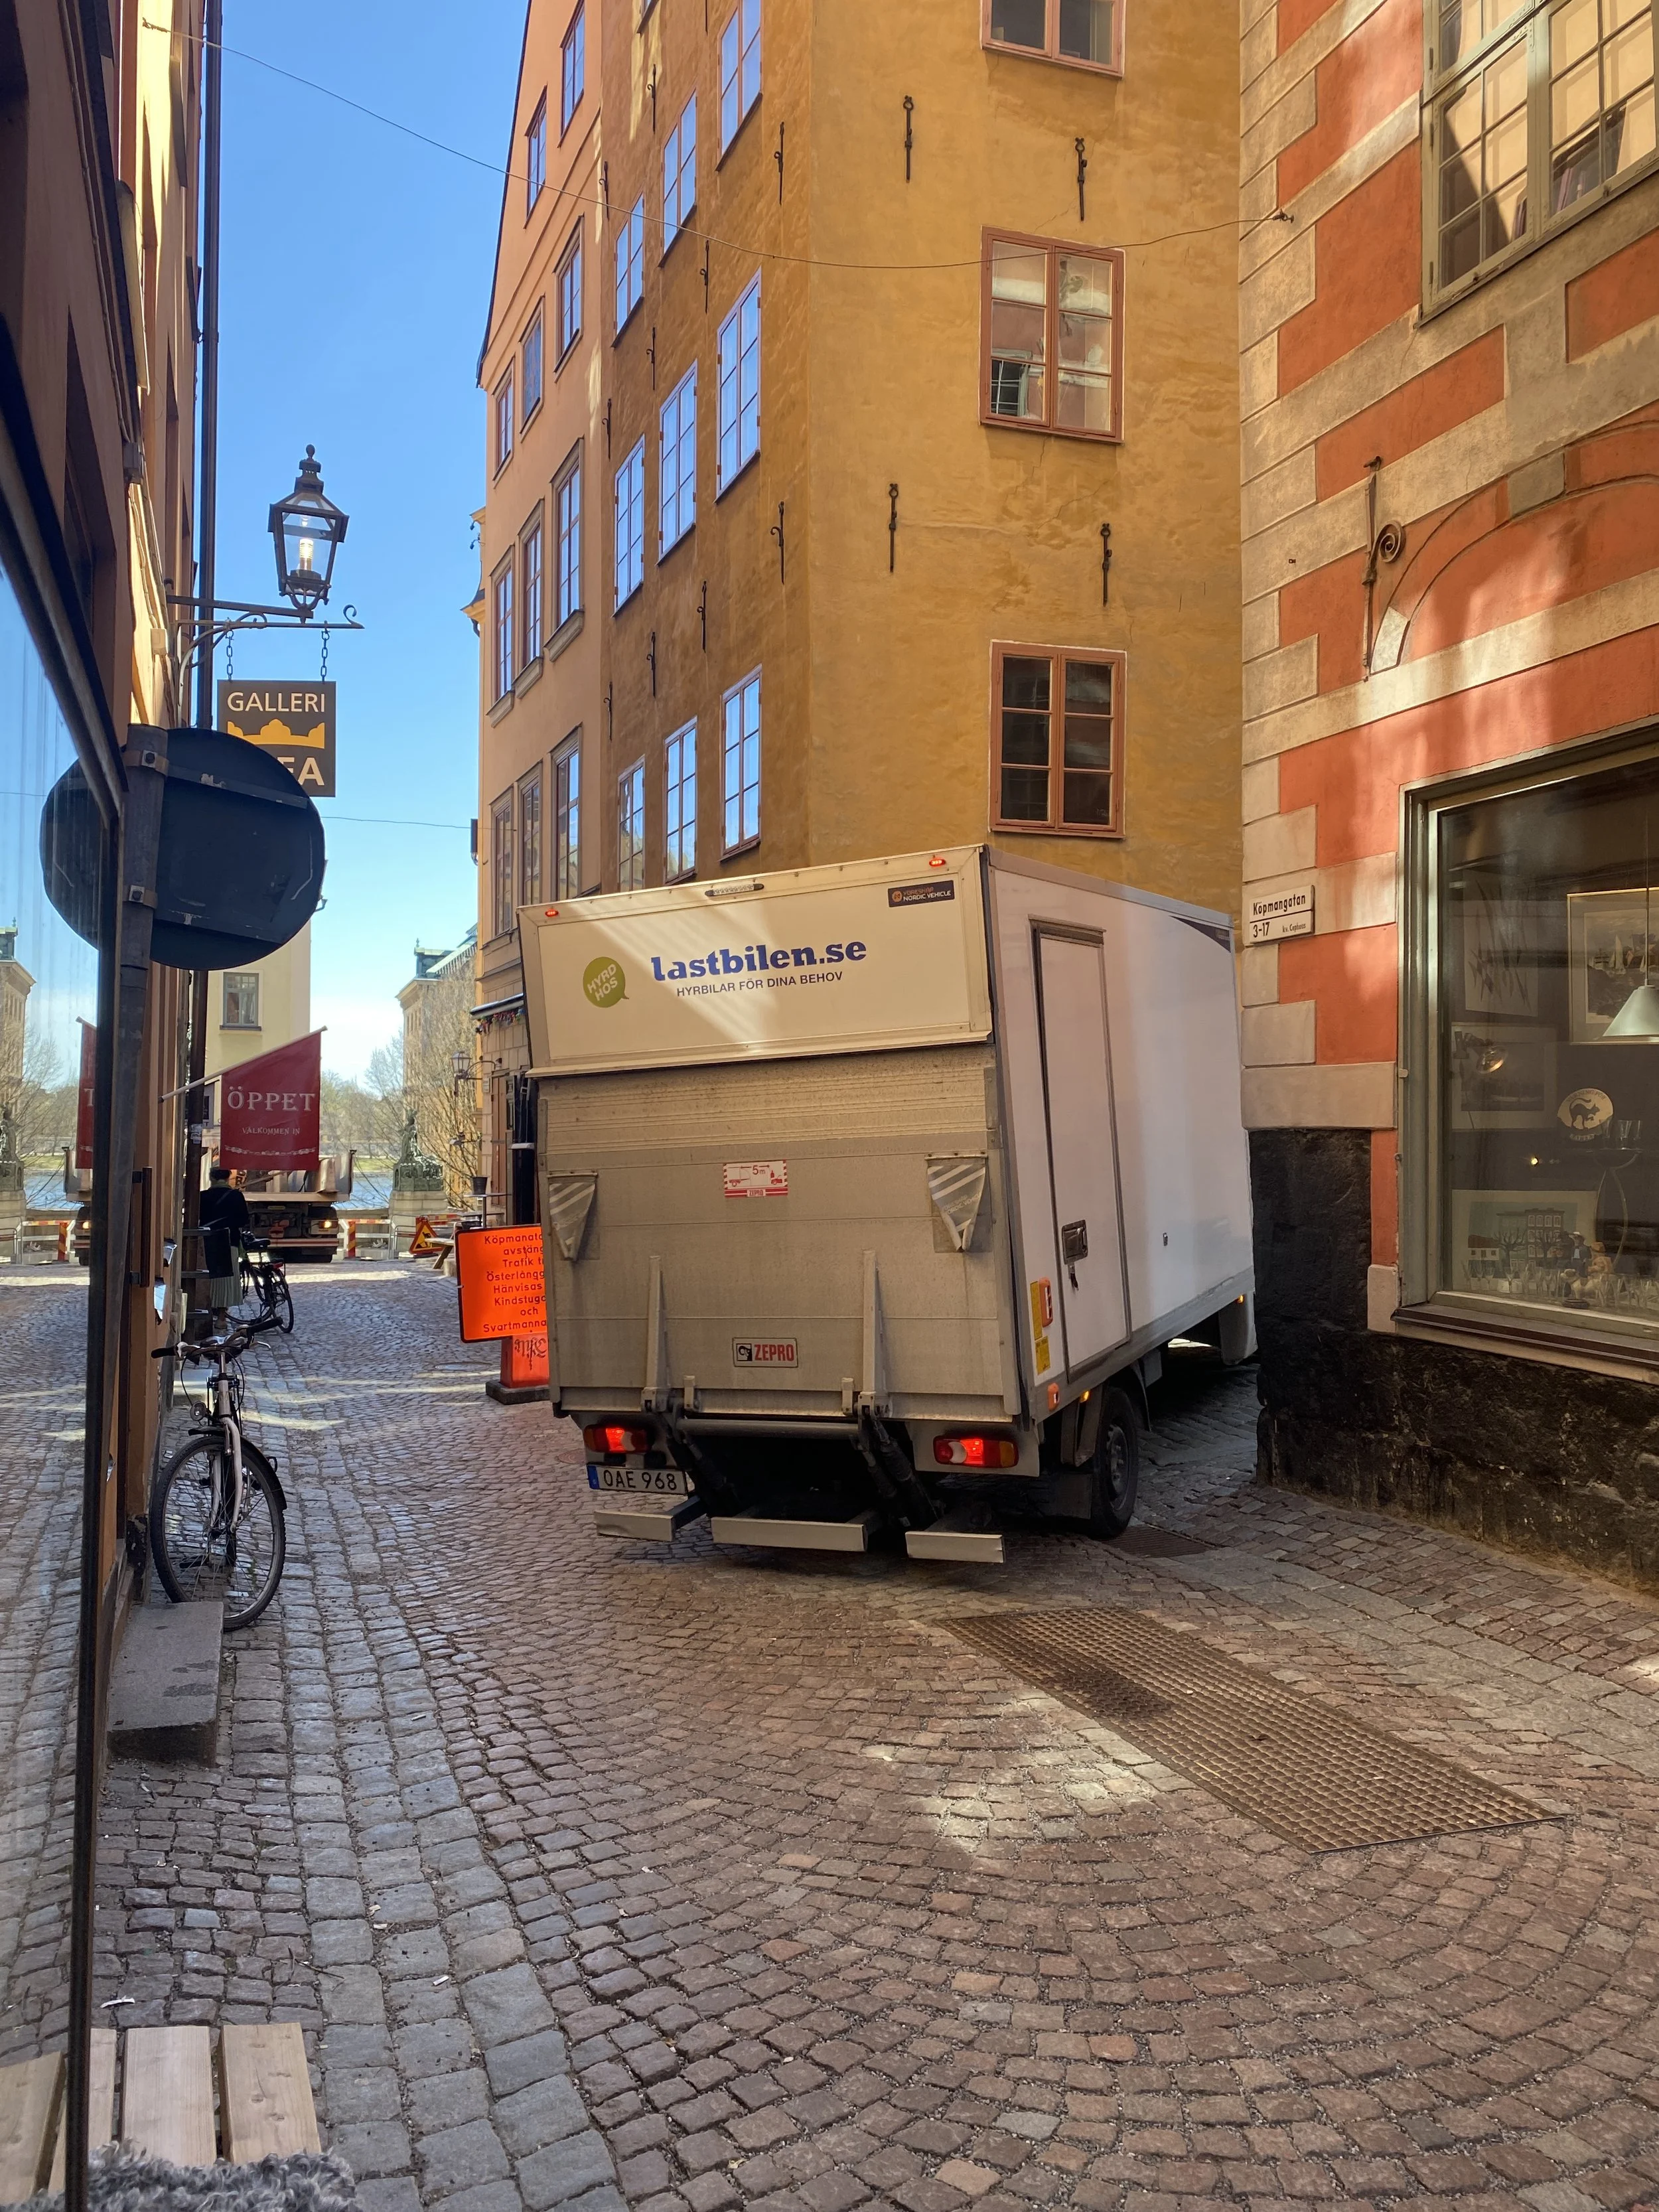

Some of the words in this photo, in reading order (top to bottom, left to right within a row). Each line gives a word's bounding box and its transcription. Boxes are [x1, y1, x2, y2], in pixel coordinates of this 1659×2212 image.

[227, 692, 325, 712] GALLERI
[926, 890, 951, 899] VEHICLE
[1253, 893, 1306, 917] Köpmangatan
[1253, 921, 1270, 938] 3-17
[650, 941, 867, 982] lastbilen.se
[587, 964, 617, 994] HYRD
[595, 976, 618, 1001] HOS
[676, 982, 735, 997] HYRBILAR
[739, 978, 764, 990] FÖR
[767, 976, 796, 988] DINA
[800, 971, 843, 985] BEHOV
[227, 1086, 315, 1112] ÖPPET
[293, 1127, 300, 1136] IN
[502, 1257, 534, 1268] Trafik
[494, 1283, 543, 1294] Hänvisas
[520, 1307, 538, 1316] och
[483, 1319, 546, 1333] Svartmanna
[754, 1343, 794, 1361] ZEPRO
[603, 1469, 636, 1489] OAE
[641, 1471, 677, 1491] 968
